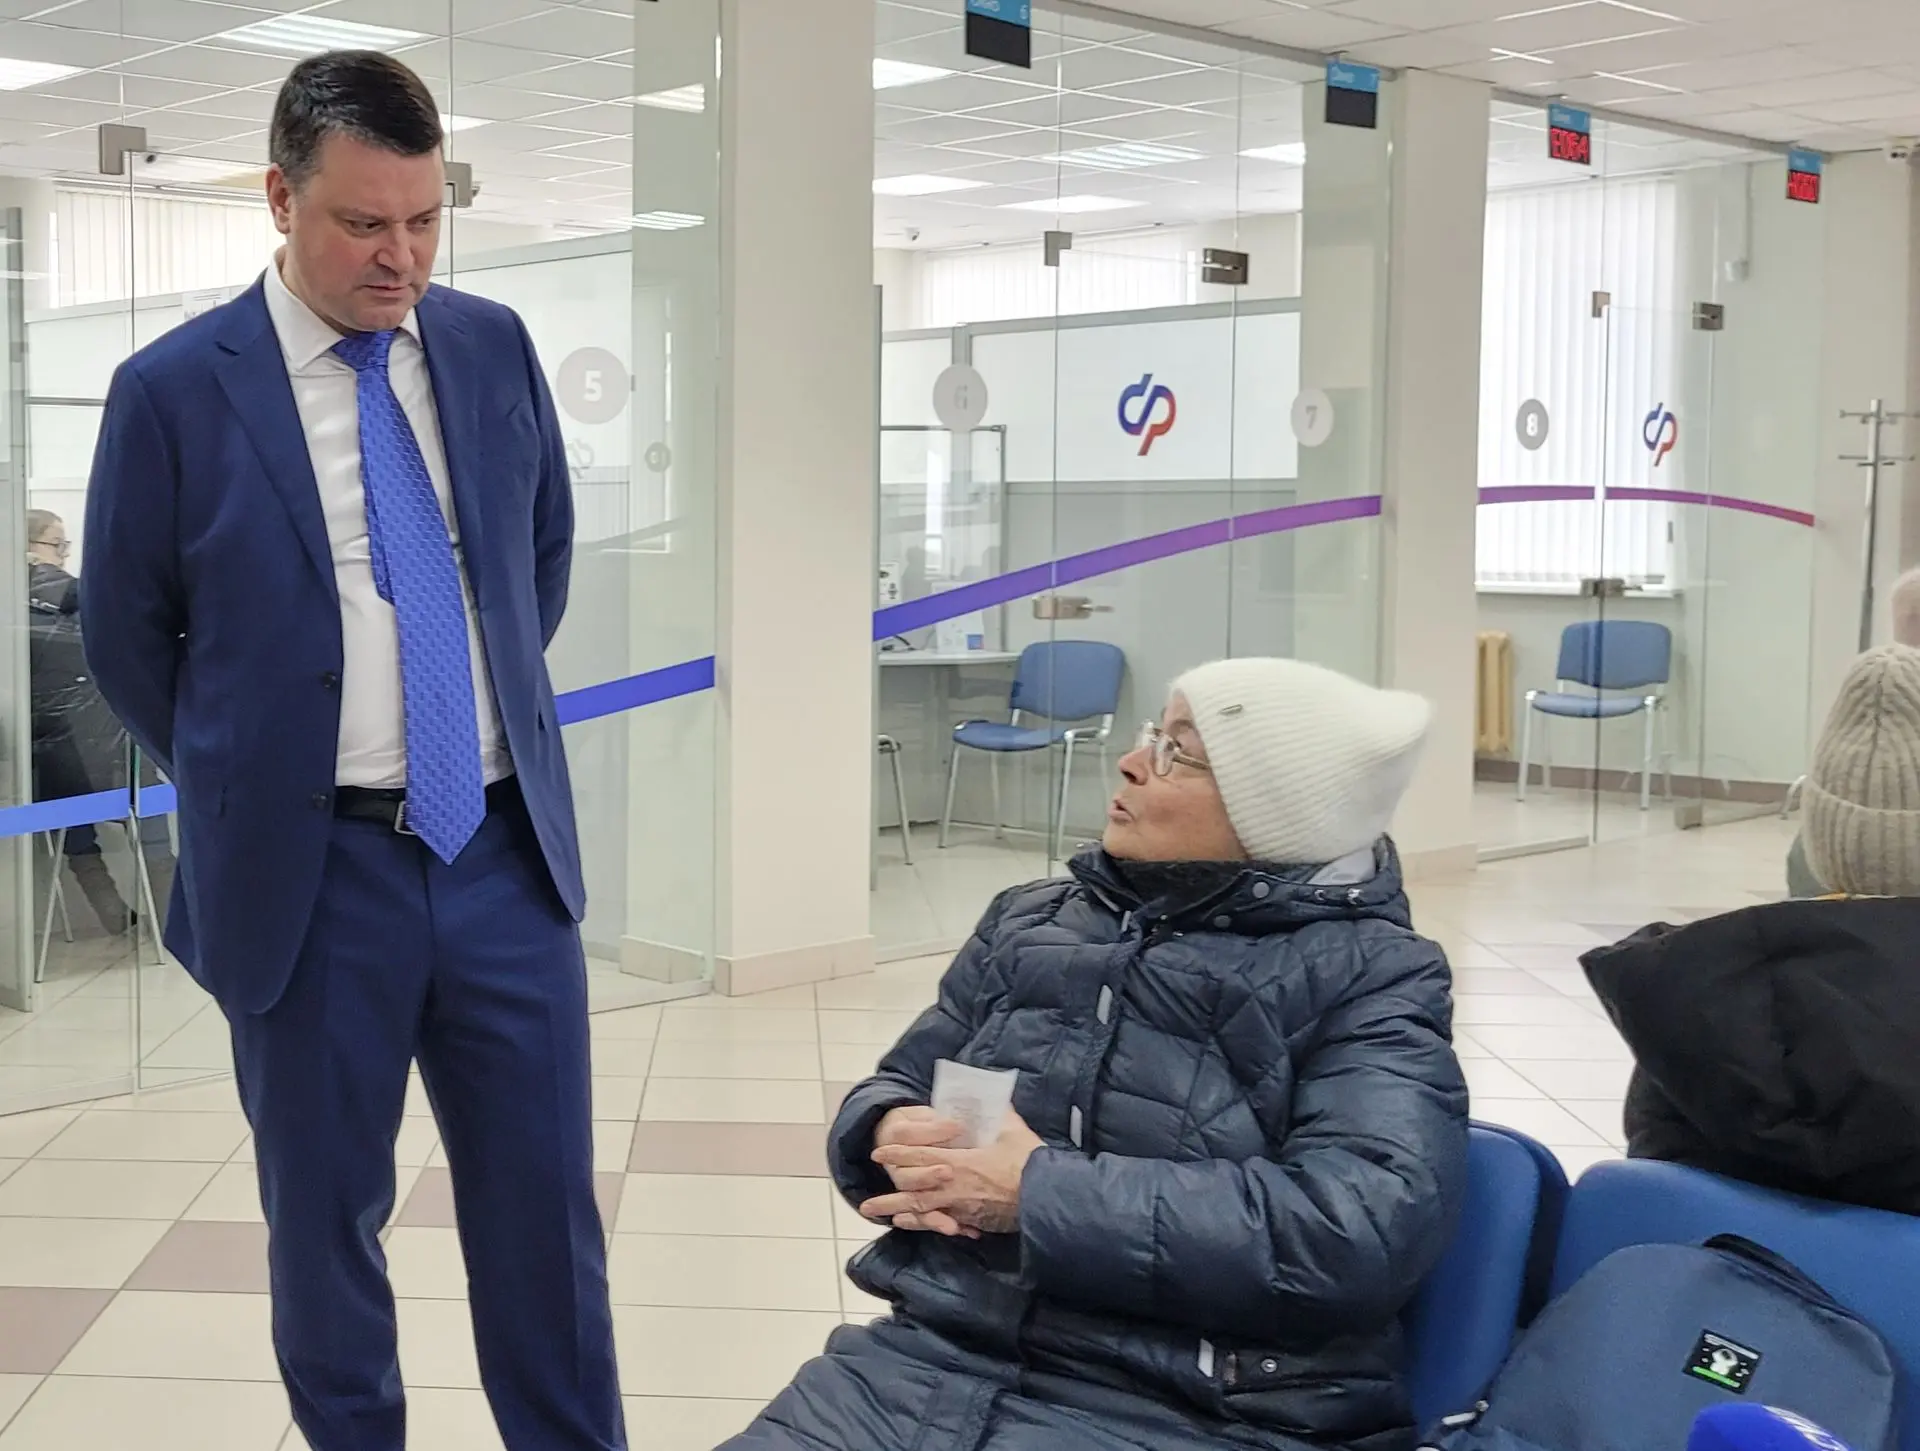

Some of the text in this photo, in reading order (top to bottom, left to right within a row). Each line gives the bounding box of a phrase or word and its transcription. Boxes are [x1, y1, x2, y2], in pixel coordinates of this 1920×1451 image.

[582, 369, 603, 402] 5
[1305, 405, 1318, 430] 7
[1526, 412, 1539, 437] 8
